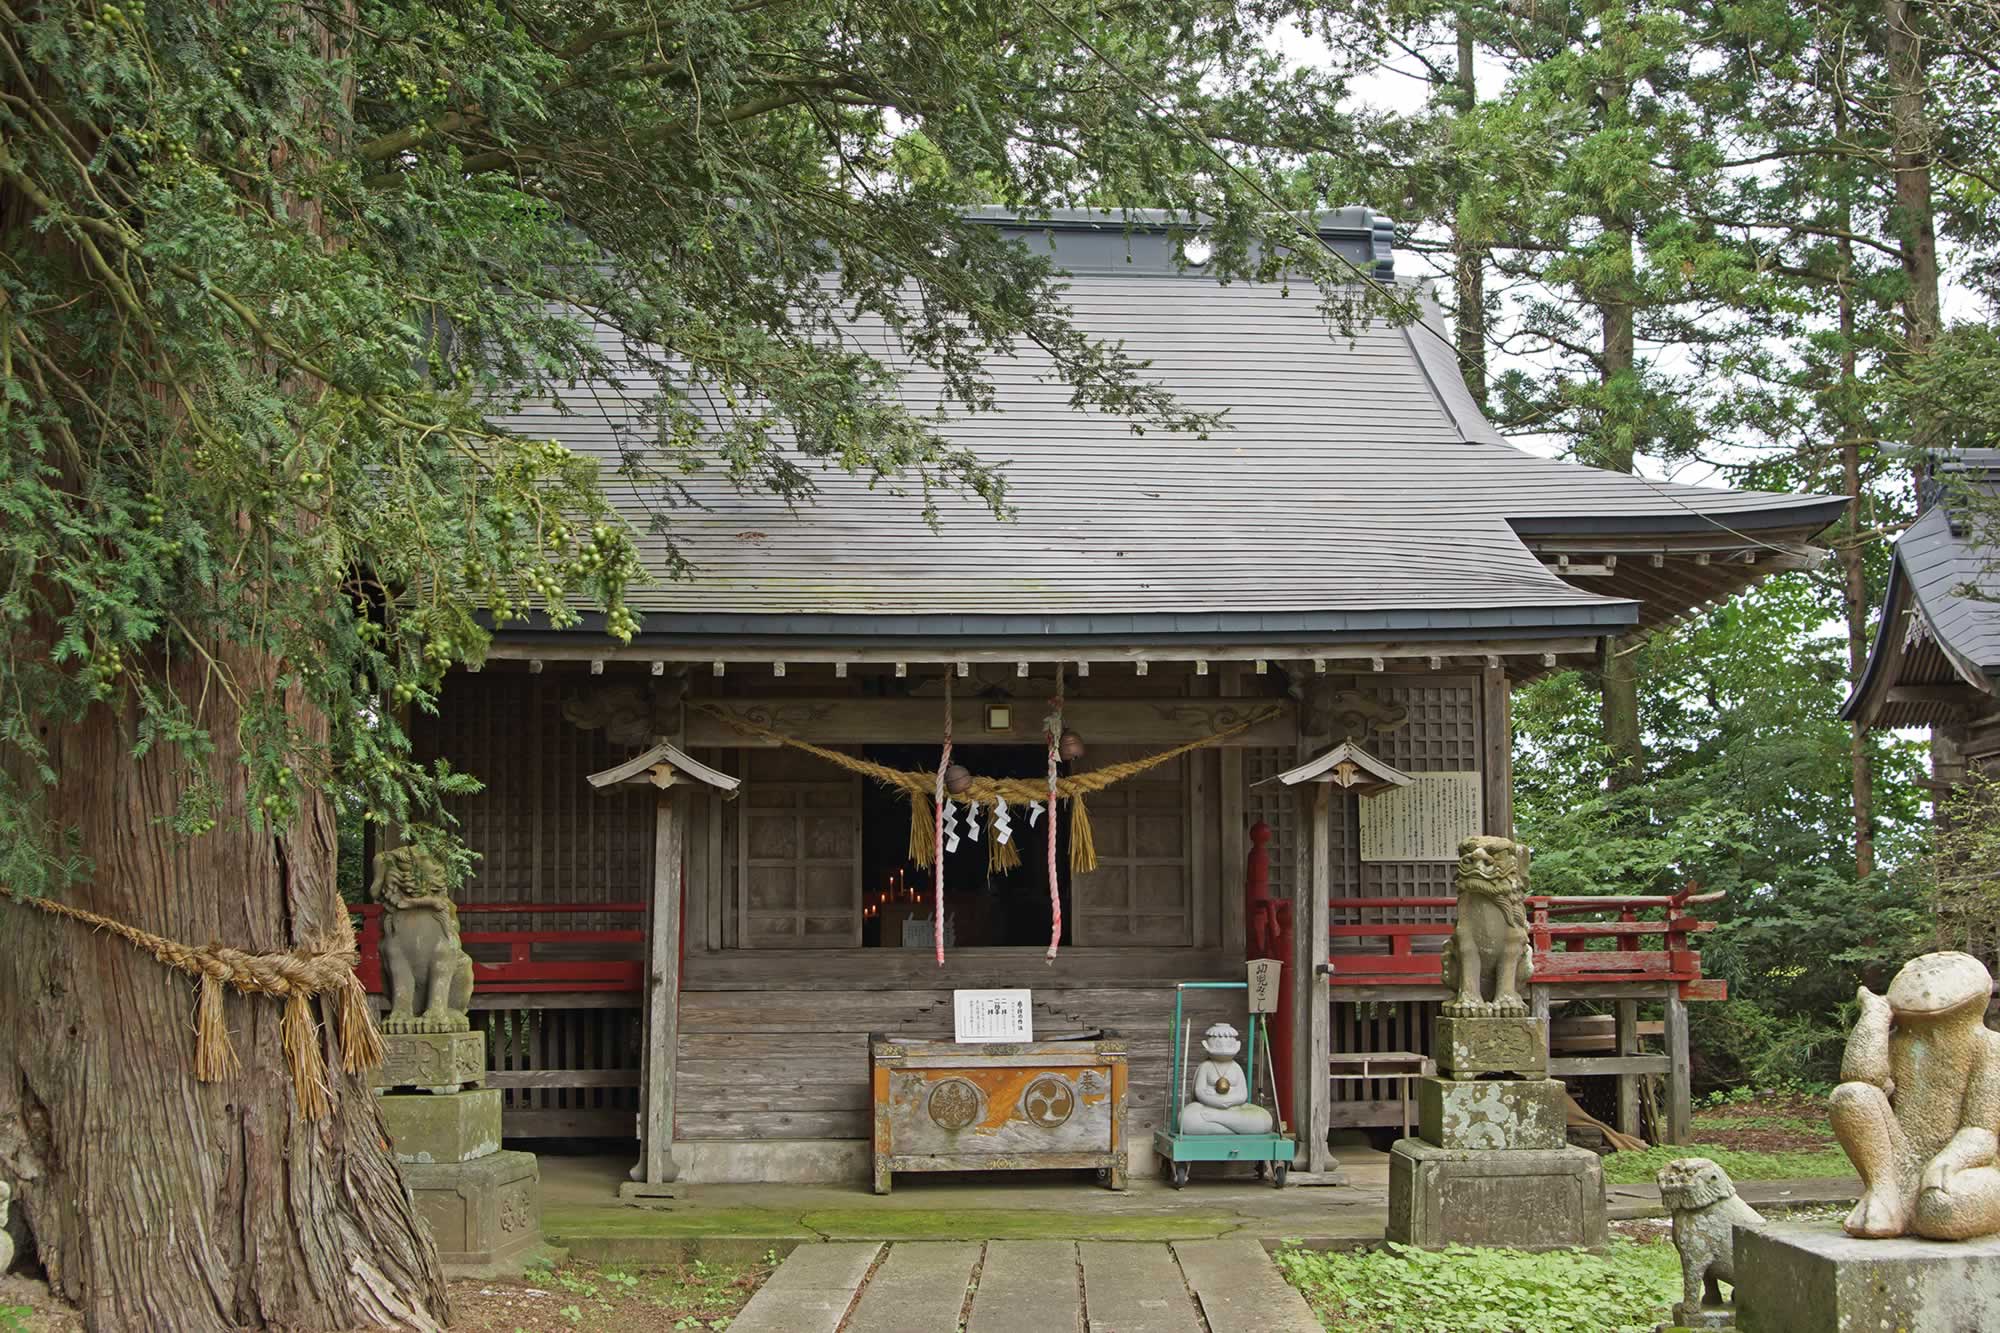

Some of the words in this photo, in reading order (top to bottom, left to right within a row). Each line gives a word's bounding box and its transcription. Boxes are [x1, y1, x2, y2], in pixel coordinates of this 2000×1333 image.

[1256, 963, 1268, 1012] 幼児みこし
